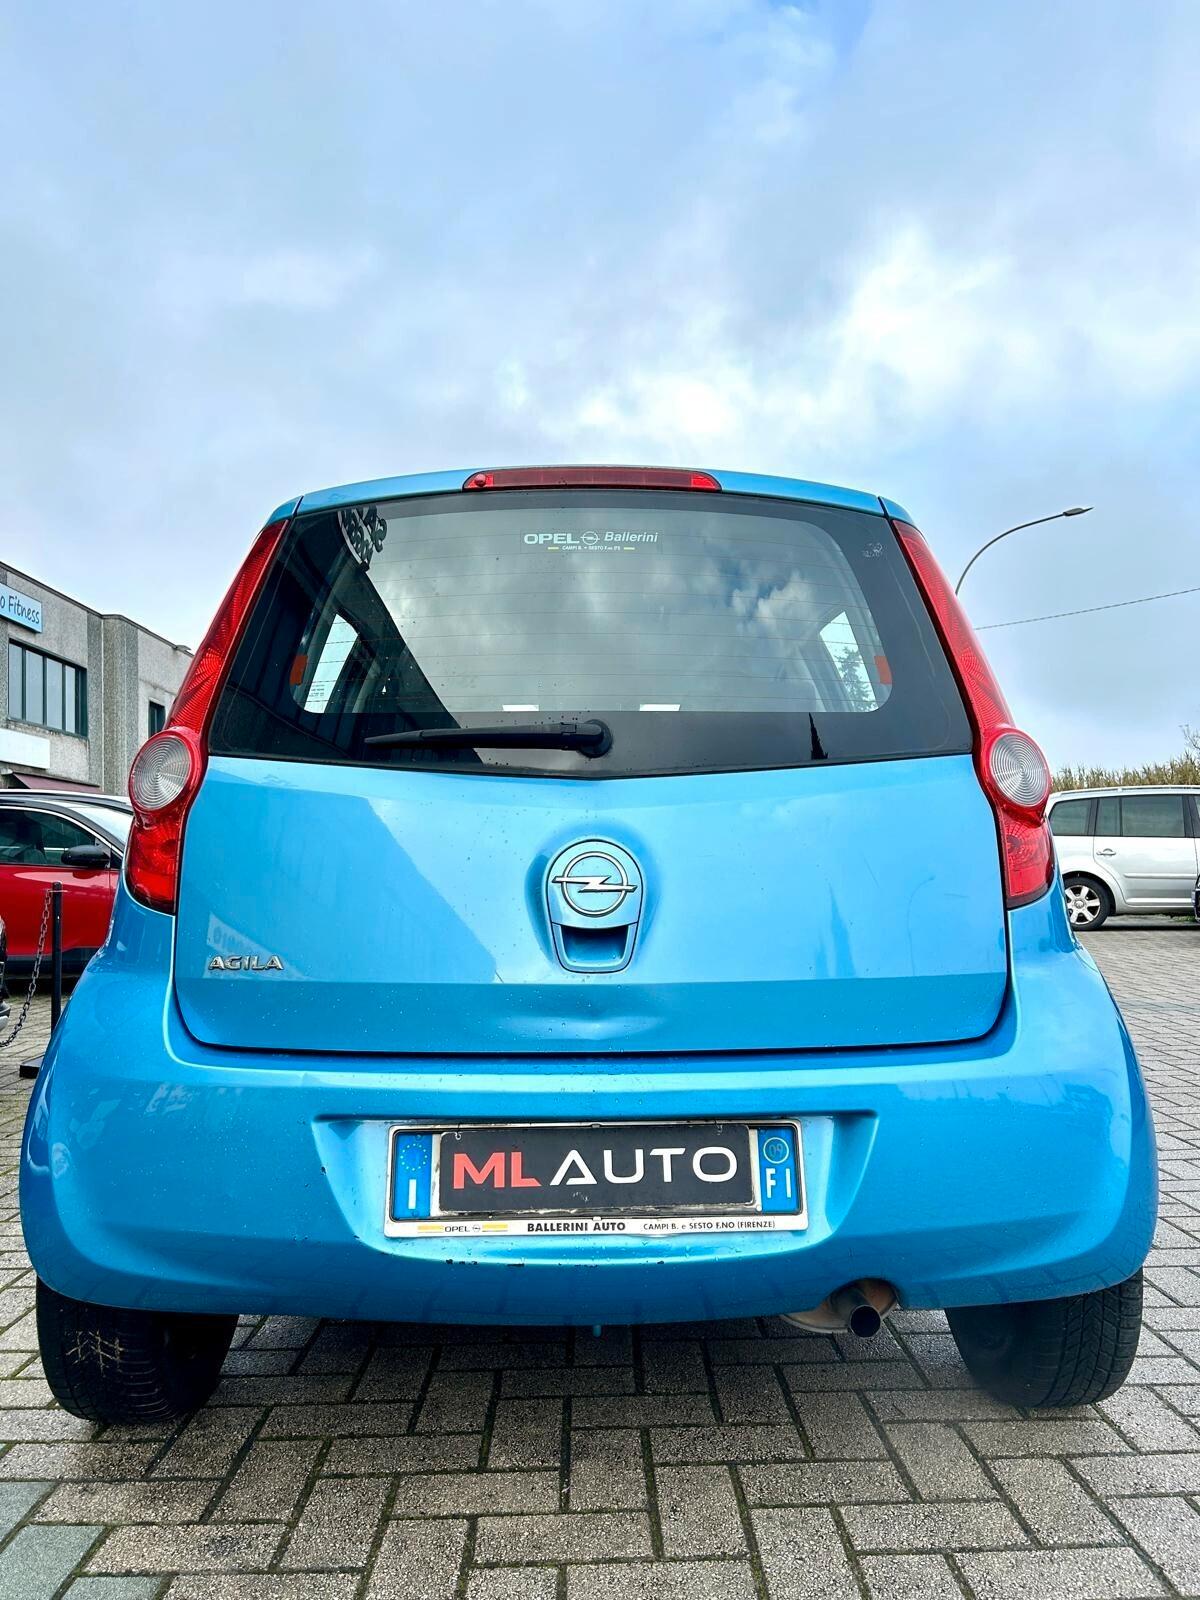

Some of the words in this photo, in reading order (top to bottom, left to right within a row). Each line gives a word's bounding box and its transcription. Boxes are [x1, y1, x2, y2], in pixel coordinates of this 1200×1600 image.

[524, 533, 580, 545] OPEL
[604, 531, 659, 543] Ballerini
[8, 595, 40, 624] Fitness
[208, 955, 284, 970] AGILA
[453, 1152, 542, 1190] ML
[550, 1146, 738, 1186] AUTO
[408, 1178, 417, 1210] I
[444, 1225, 471, 1233] OPEL
[527, 1222, 588, 1232] BALLERINI
[593, 1222, 626, 1231] AUTO
[643, 1223, 669, 1231] CAMPI
[671, 1222, 679, 1230] B.
[688, 1221, 714, 1229] SESTO
[716, 1221, 735, 1229] F.NO
[737, 1220, 776, 1229] (FIRENZE)
